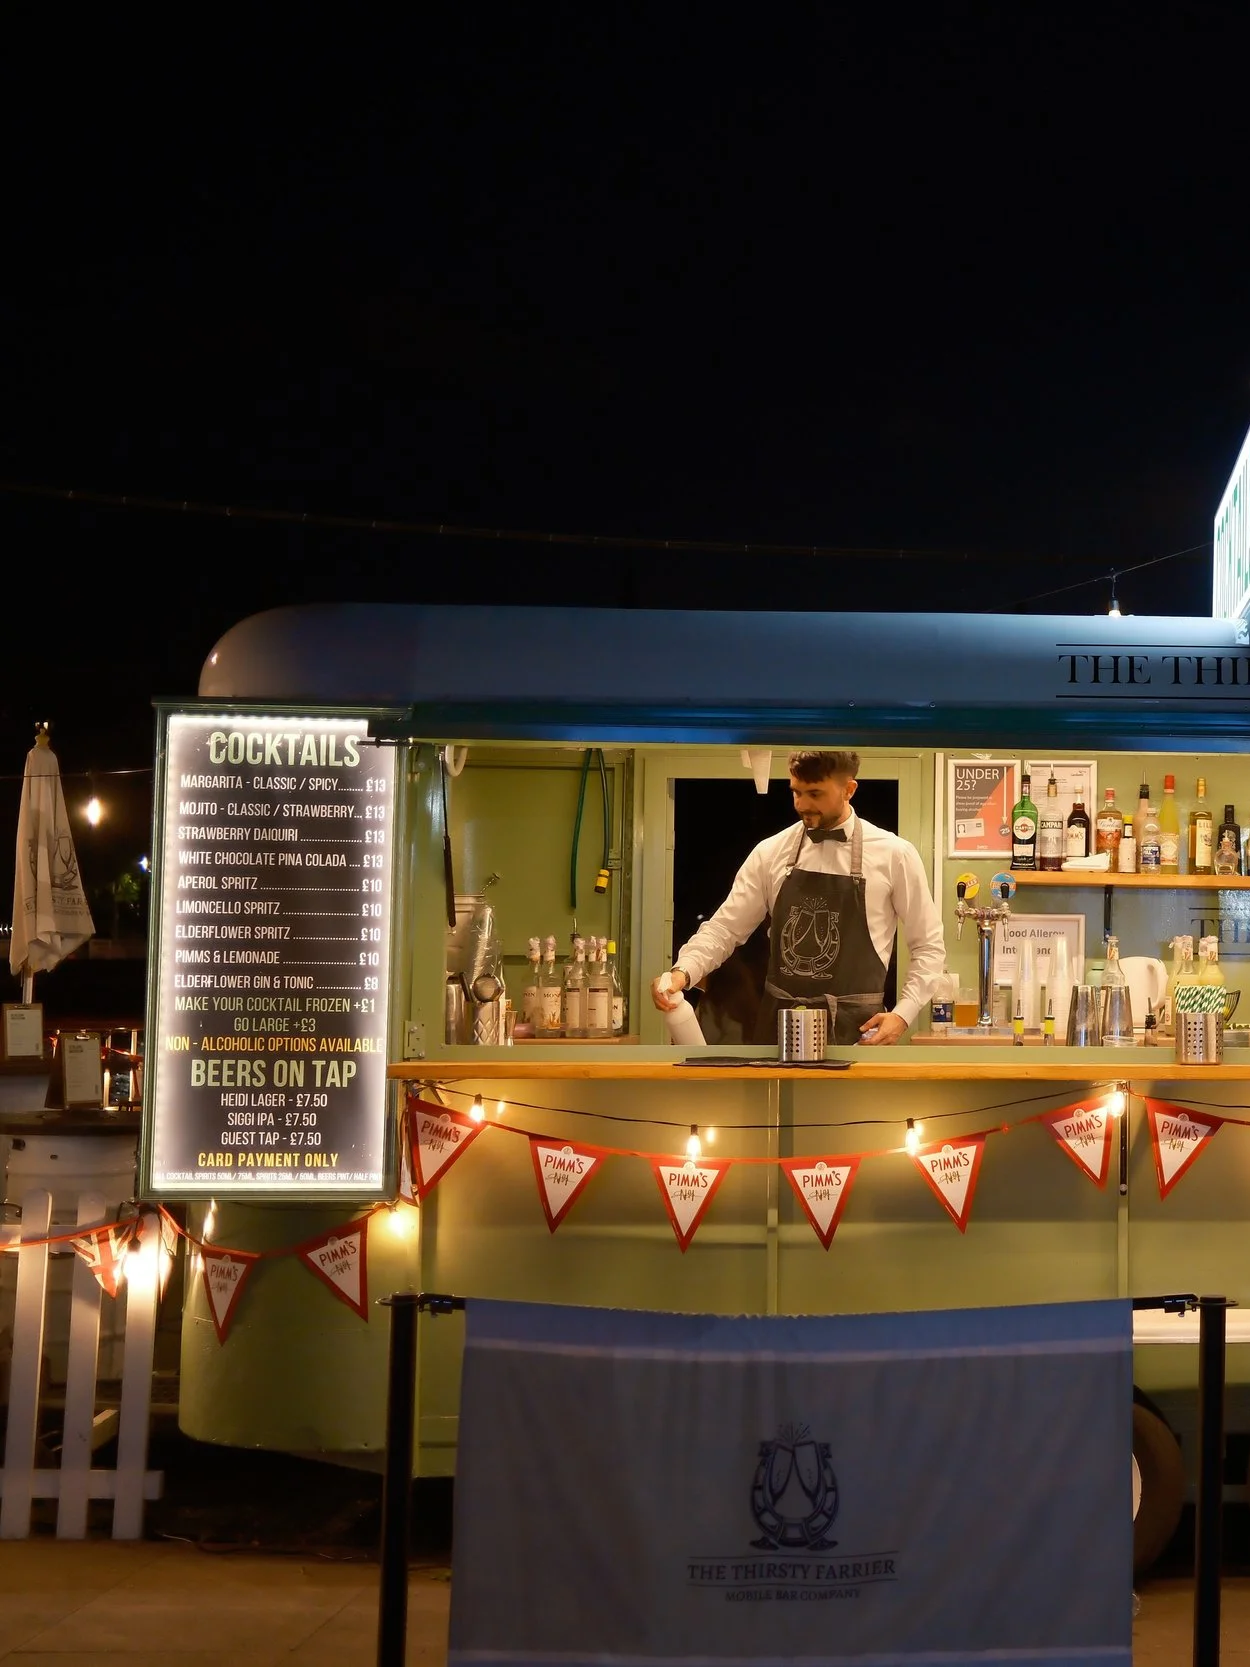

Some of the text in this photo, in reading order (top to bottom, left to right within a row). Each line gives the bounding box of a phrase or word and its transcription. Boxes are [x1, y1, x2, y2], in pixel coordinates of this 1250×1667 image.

[1057, 654, 1151, 684] THE
[209, 732, 361, 767] COCKTAILS
[956, 768, 999, 780] UNDER
[180, 775, 243, 789] MARGARITA
[253, 777, 297, 790] CLASSIC
[365, 779, 386, 792] £13
[956, 780, 976, 791] 25?
[179, 802, 217, 816] MOJITO
[227, 804, 271, 816] CLASSIC
[365, 805, 385, 819] £13
[177, 827, 385, 844] STRAWBERRY DAIQUIRI £13
[178, 852, 383, 868] WHITE CHOCOLATE PINA COLADA £13
[177, 877, 382, 892] APEROL SPRITZ £10
[175, 901, 382, 917] LIMONCELLO SPRITZ £10
[175, 926, 381, 941] ELDERFLOWER SPRITZ £10
[175, 951, 379, 965] PIMMS & LEMONADE £10
[174, 975, 378, 990] ELDERFLOWER GIN & TONIC £8
[174, 997, 375, 1013] MAKE YOUR COCKTAIL FROZEN +£1
[233, 1018, 316, 1032] GO LARGE +£3
[165, 1037, 384, 1052] NON ALCOHOLIC OPTIONS AVAILABLE
[190, 1060, 357, 1088] BEERS ON TAP
[220, 1093, 328, 1107] HEIDI LAGER £7.50
[227, 1113, 317, 1126] SIGGI IPA £7.50
[1063, 1113, 1104, 1138] PIMM'S
[220, 1132, 321, 1145] GUEST TAP £7.50
[420, 1118, 461, 1144] PIMM'S
[1160, 1119, 1201, 1142] PIMM'S
[198, 1153, 339, 1168] CARD PAYMENT ONLY
[543, 1153, 585, 1175] PIMM'S
[929, 1150, 970, 1173] PIMM'S
[668, 1170, 709, 1188] PIMM'S
[801, 1170, 842, 1189] PIMM'S
[318, 1239, 357, 1267] PIMM'S
[210, 1263, 239, 1283] PIMM'S
[687, 1559, 896, 1580] THE THIRSTY FARRIER
[725, 1589, 861, 1601] MOBILE BAR COMPANY
